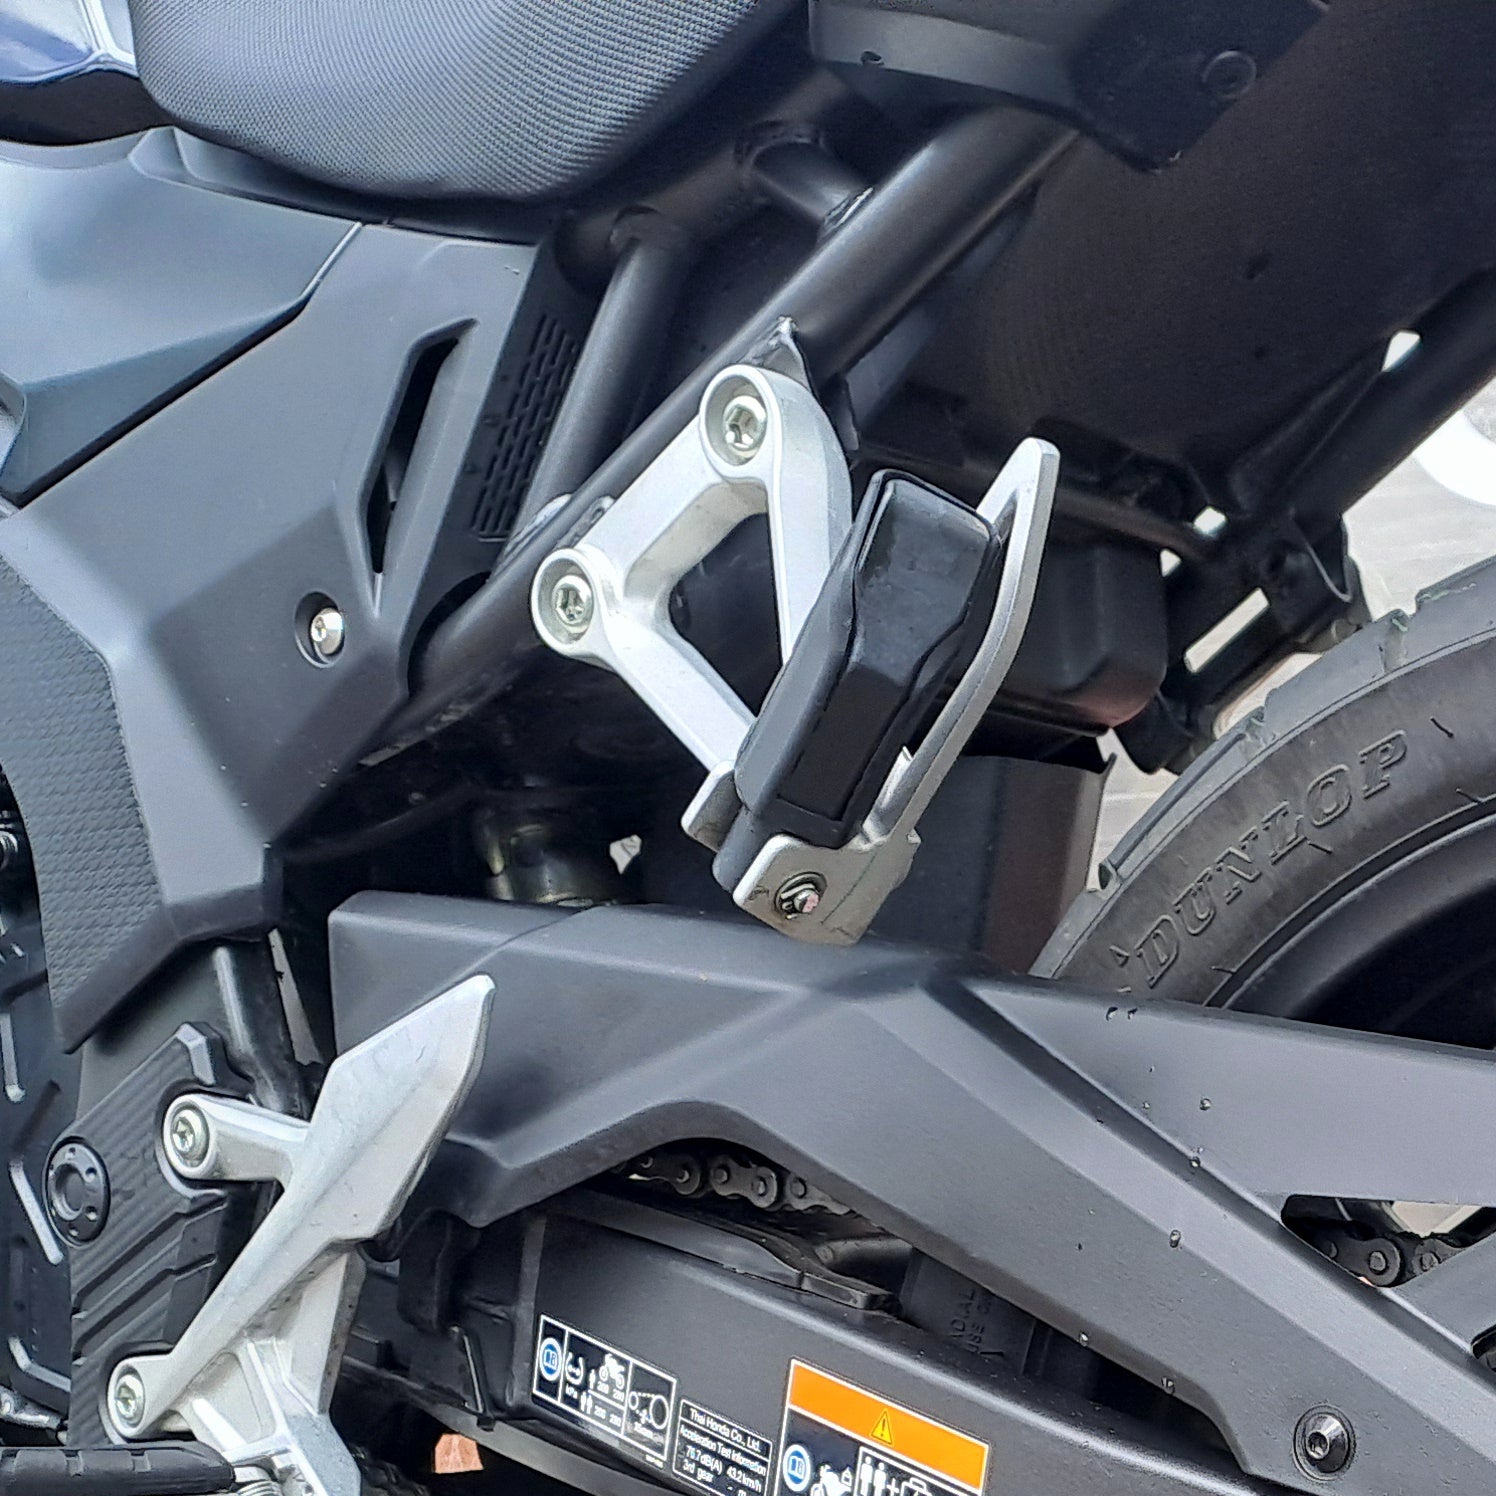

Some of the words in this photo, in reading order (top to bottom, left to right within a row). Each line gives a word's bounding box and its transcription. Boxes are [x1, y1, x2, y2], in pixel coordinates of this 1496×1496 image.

[1137, 730, 1407, 990] DUNLOP
[690, 1408, 706, 1426] Thai
[706, 1417, 730, 1437] Honda
